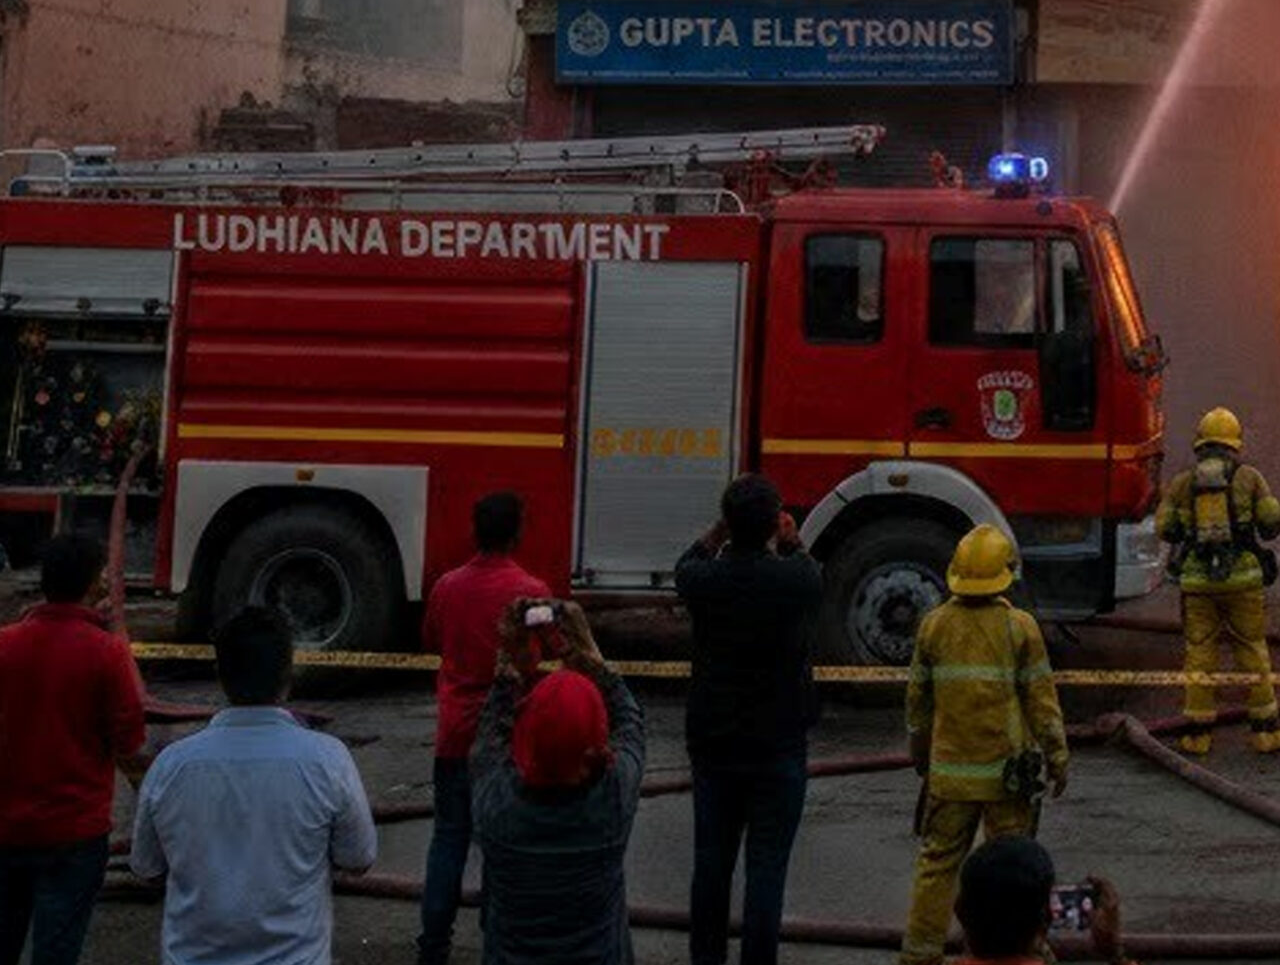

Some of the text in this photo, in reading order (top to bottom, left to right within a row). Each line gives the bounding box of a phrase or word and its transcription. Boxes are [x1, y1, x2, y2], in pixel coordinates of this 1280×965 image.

[619, 17, 995, 49] GUPTA ELECTRONICS
[172, 212, 671, 261] LUDHIANA DEPARTMENT
